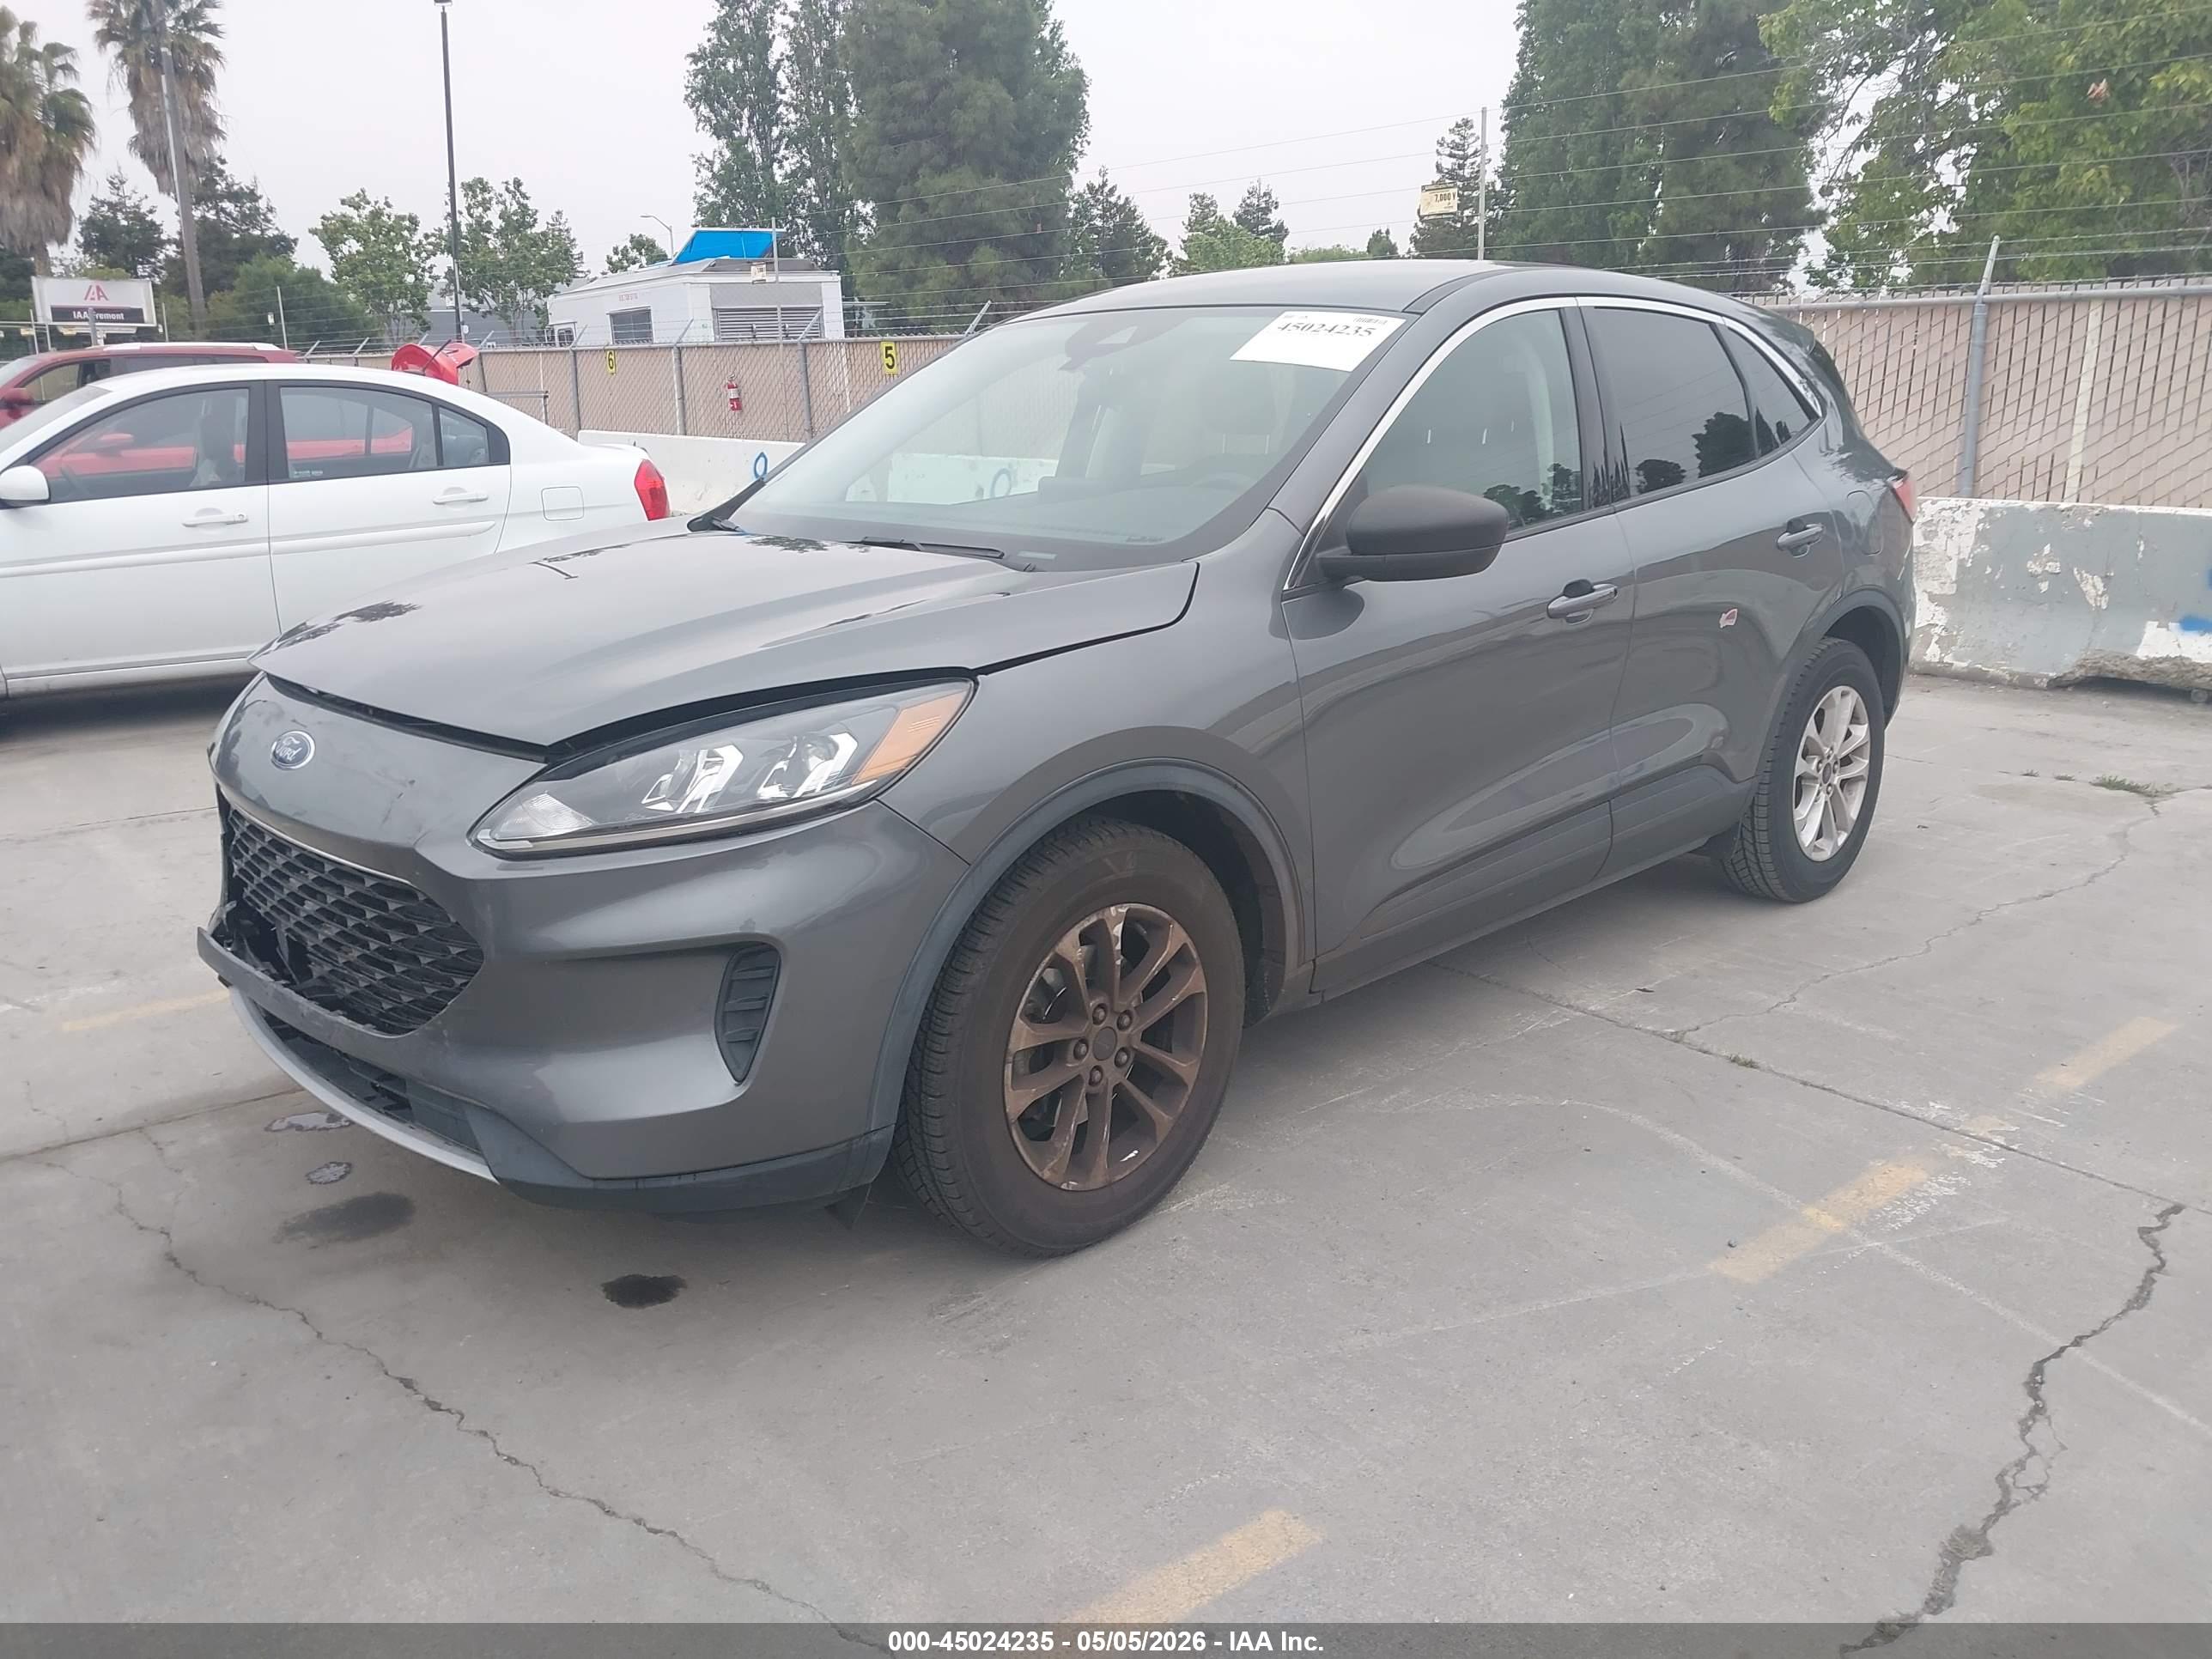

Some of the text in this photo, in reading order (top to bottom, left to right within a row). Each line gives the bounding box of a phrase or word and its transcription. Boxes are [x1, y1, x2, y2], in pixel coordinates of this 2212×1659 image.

[73, 311, 90, 319] IAA
[1277, 322, 1376, 337] 45024235
[608, 351, 615, 370] 6
[884, 346, 895, 370] 5
[275, 737, 303, 762] Ford
